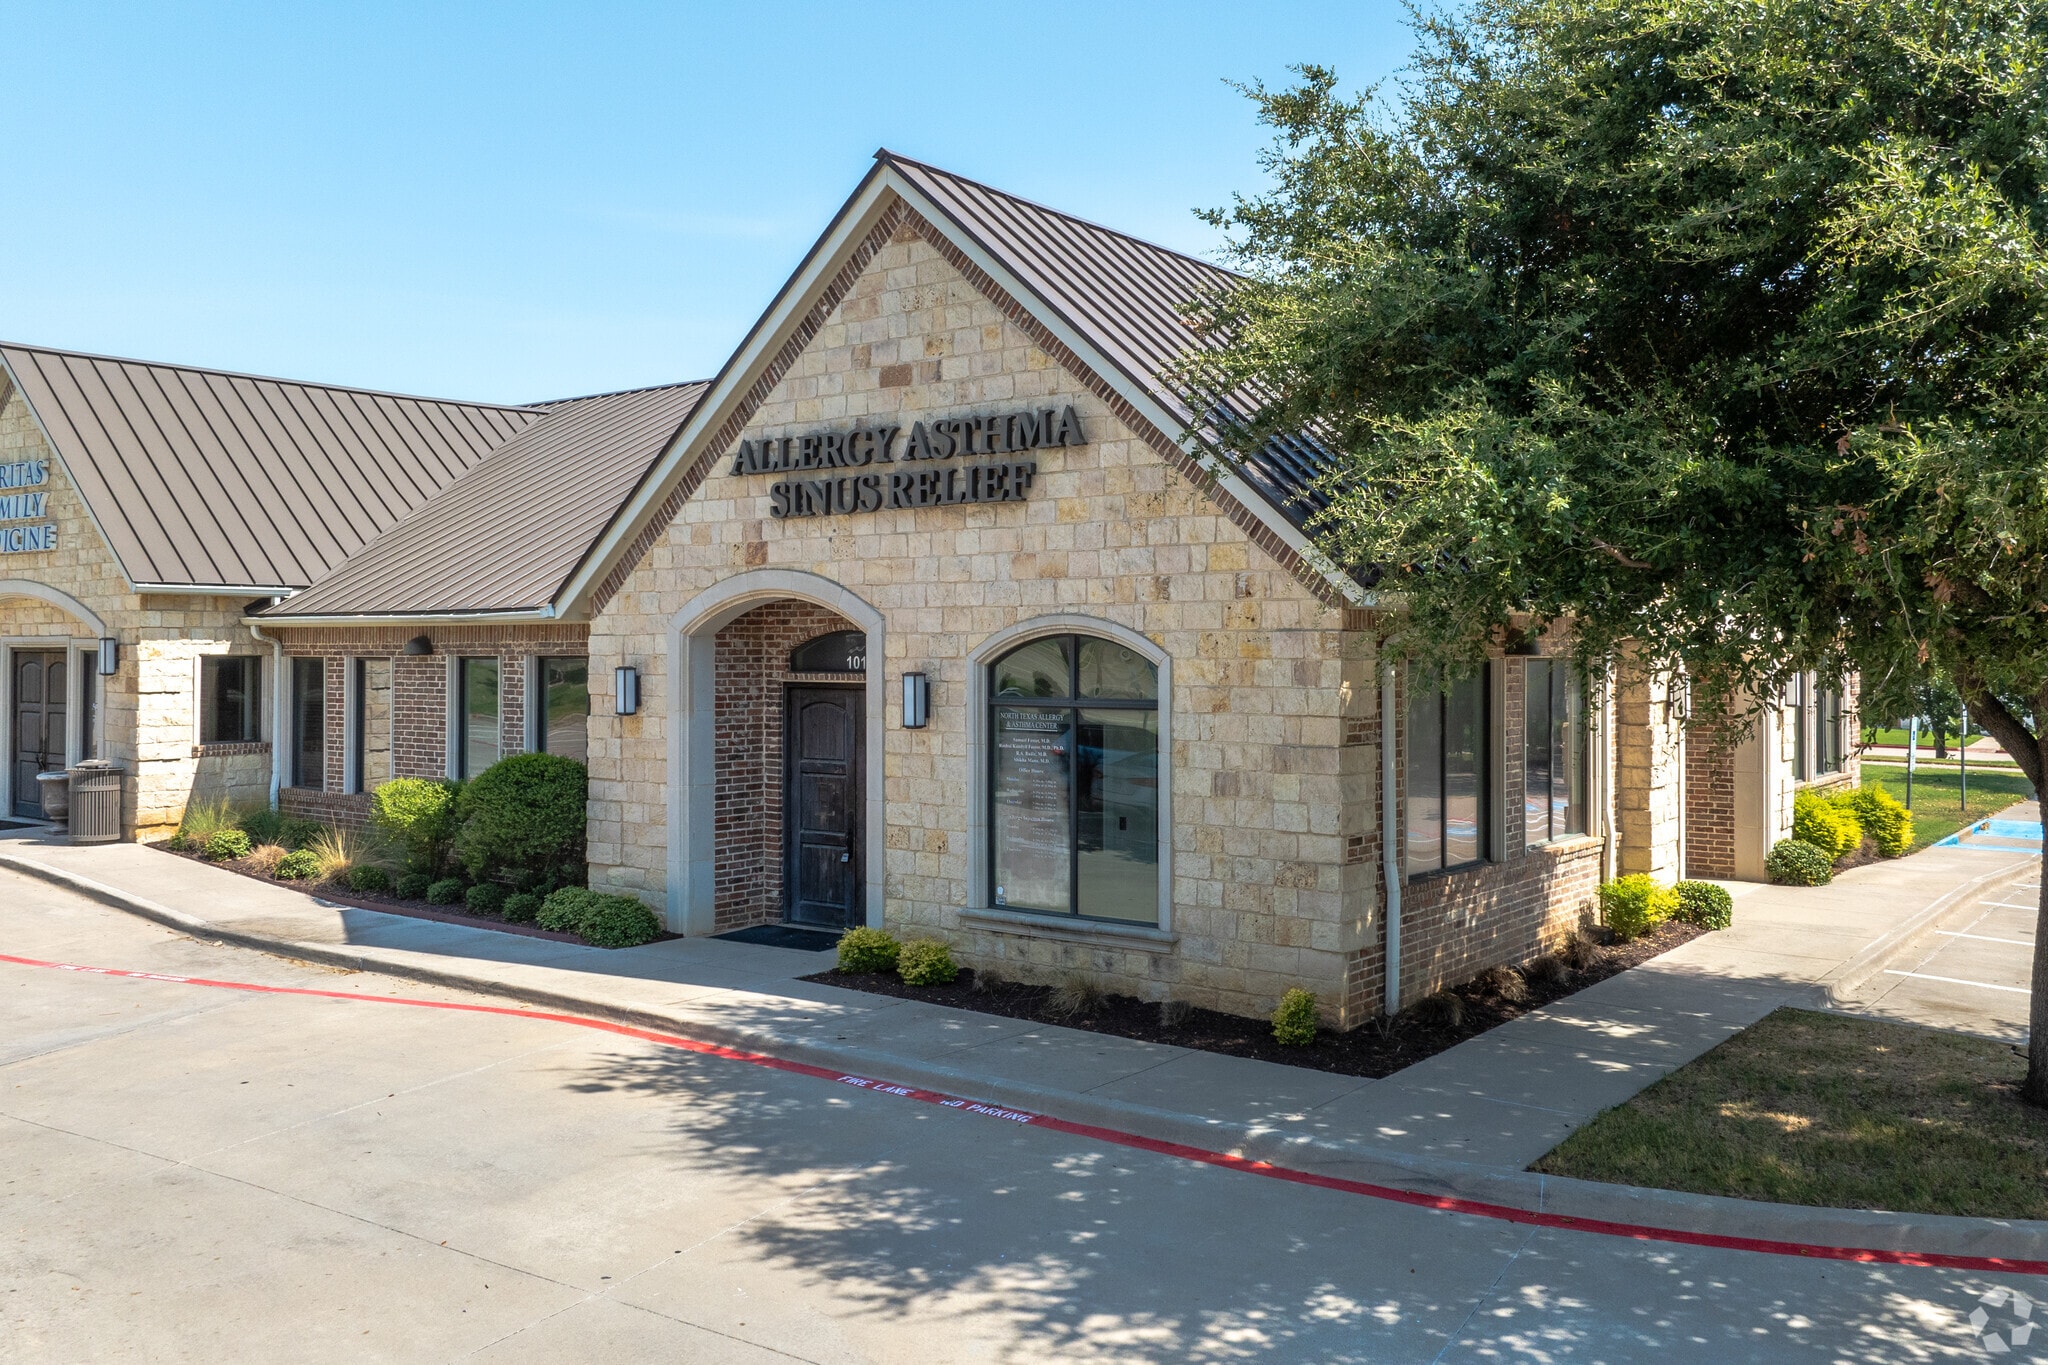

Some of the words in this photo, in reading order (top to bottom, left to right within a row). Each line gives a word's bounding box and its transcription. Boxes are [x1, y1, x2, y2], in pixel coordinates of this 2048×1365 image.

[729, 426, 901, 476] ALLERGY
[901, 404, 1088, 461] ASTHMA
[770, 474, 882, 519] SINUS
[885, 462, 1036, 509] RELIEF
[0, 526, 54, 553] ICINE
[846, 655, 866, 670] 101
[1000, 712, 1019, 720] NORTH
[1020, 712, 1037, 720] TEXAS
[1039, 713, 1065, 721] ALLERGY
[1012, 721, 1034, 729] ASTHMA
[837, 1075, 874, 1087] FIRE
[873, 1083, 916, 1096] LANE
[966, 1103, 1033, 1123] PARKING
